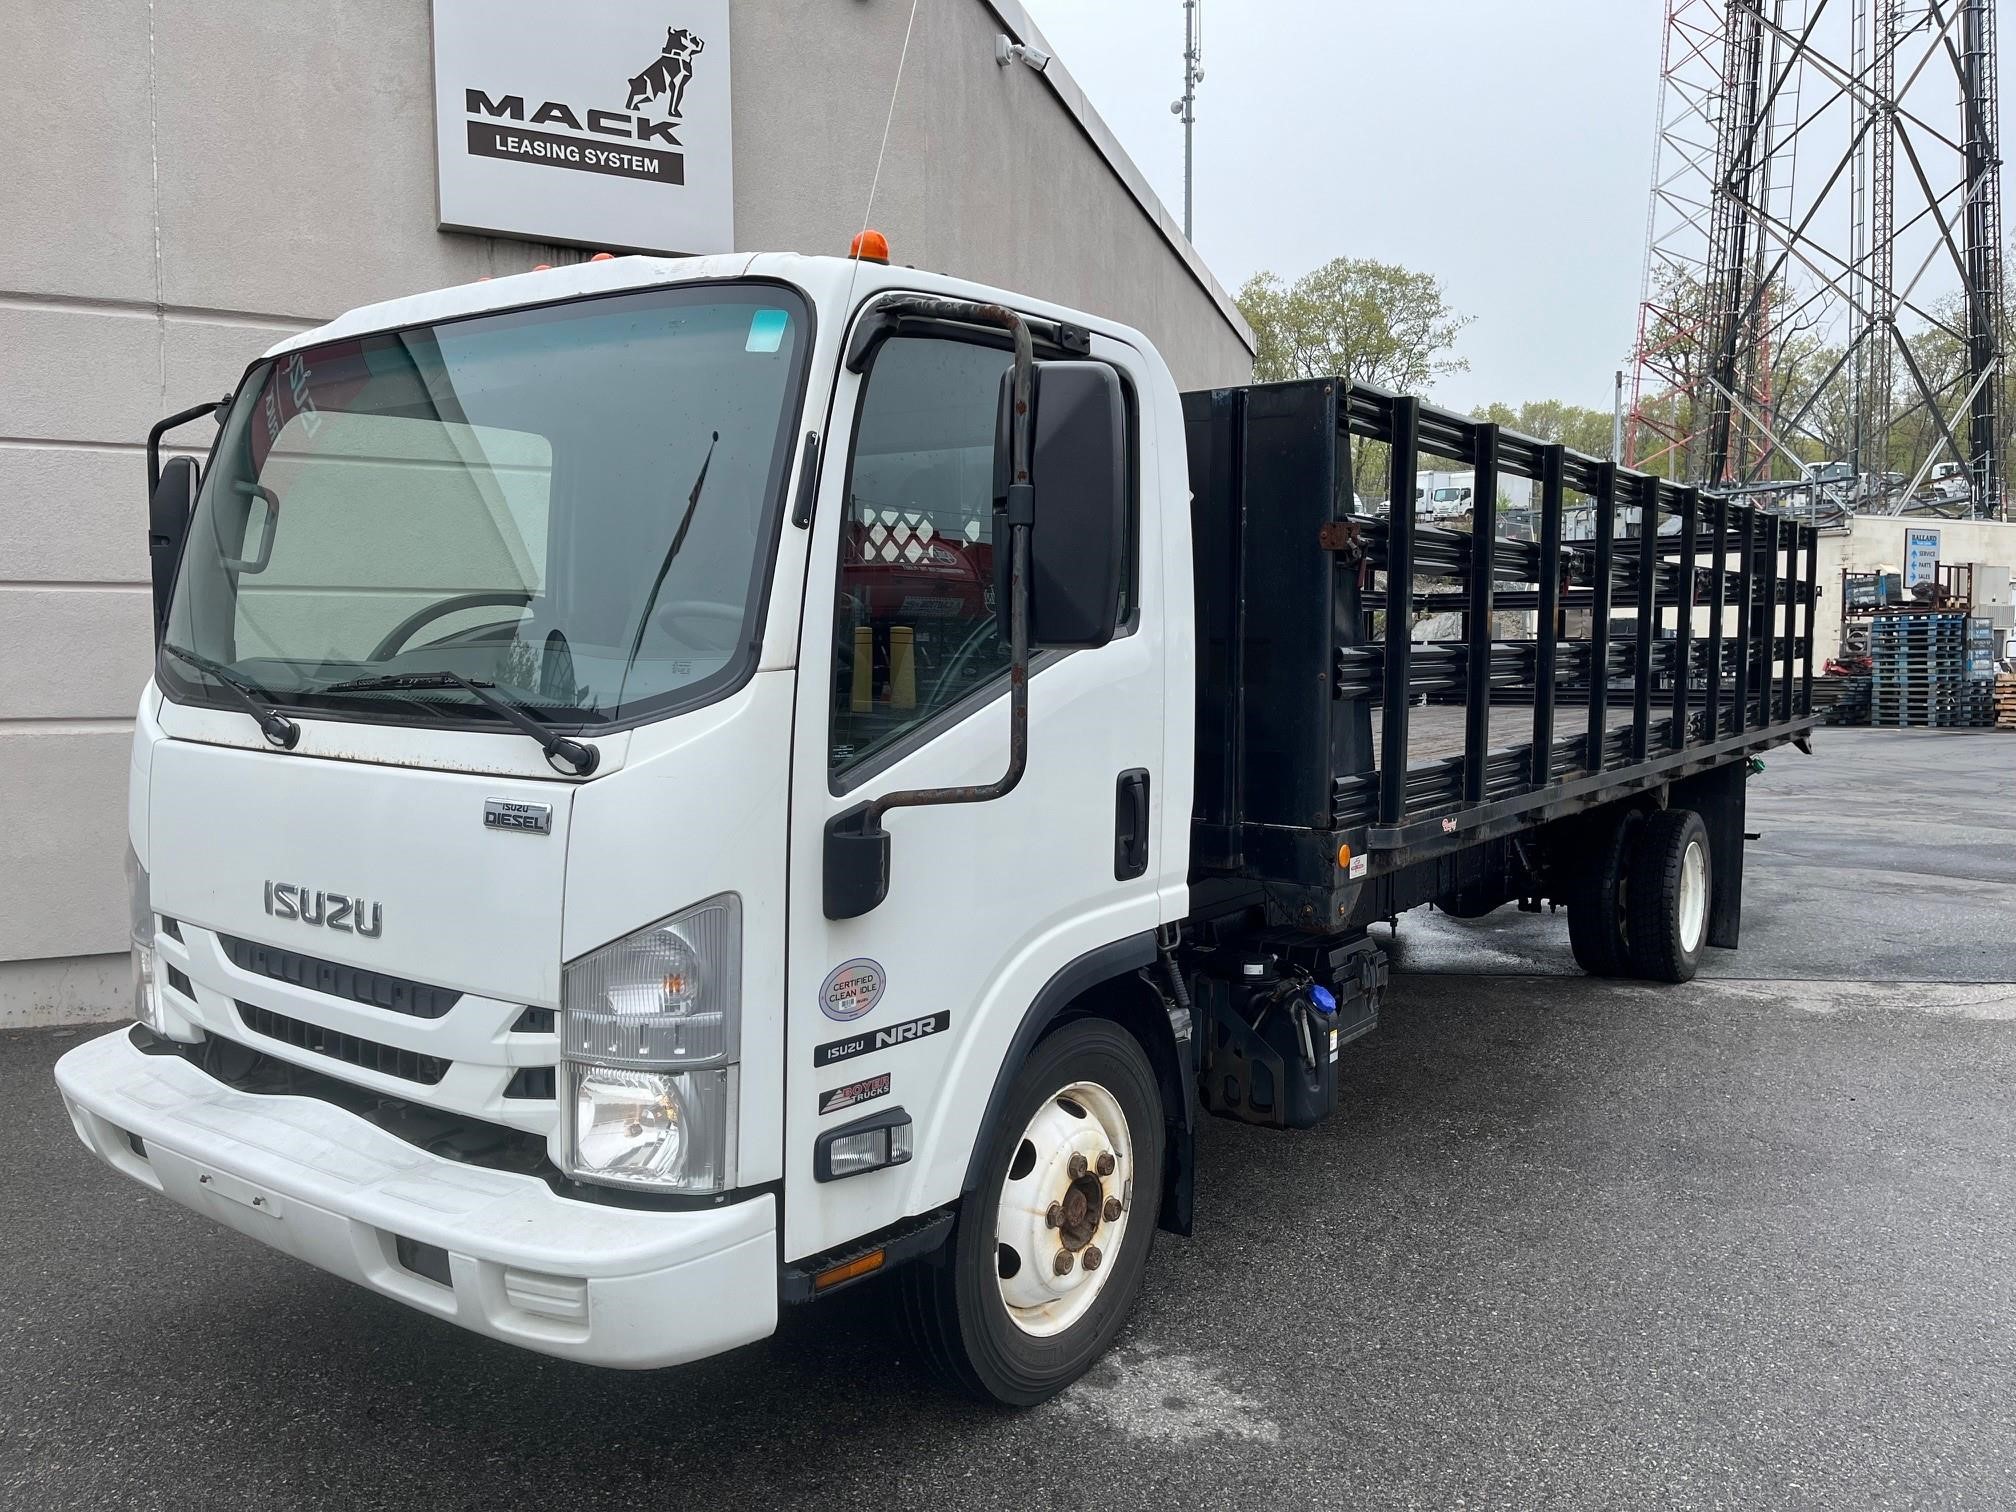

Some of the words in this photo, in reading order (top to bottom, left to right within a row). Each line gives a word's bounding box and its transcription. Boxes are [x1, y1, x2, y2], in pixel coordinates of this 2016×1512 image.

[465, 88, 684, 146] MACK
[495, 134, 580, 162] LEASING
[584, 149, 659, 174] SYSTEM
[502, 803, 529, 813] ISUZU
[485, 811, 545, 830] DIESEL
[264, 879, 382, 939] ISUZU
[829, 988, 857, 1003] CLEAN
[860, 983, 877, 994] IDLE
[833, 974, 874, 991] CERTIFIED
[827, 1040, 864, 1059] ISUZU
[875, 1017, 936, 1049] NRR
[842, 1075, 890, 1098] BOYER
[851, 1085, 890, 1102] TRUCKS
